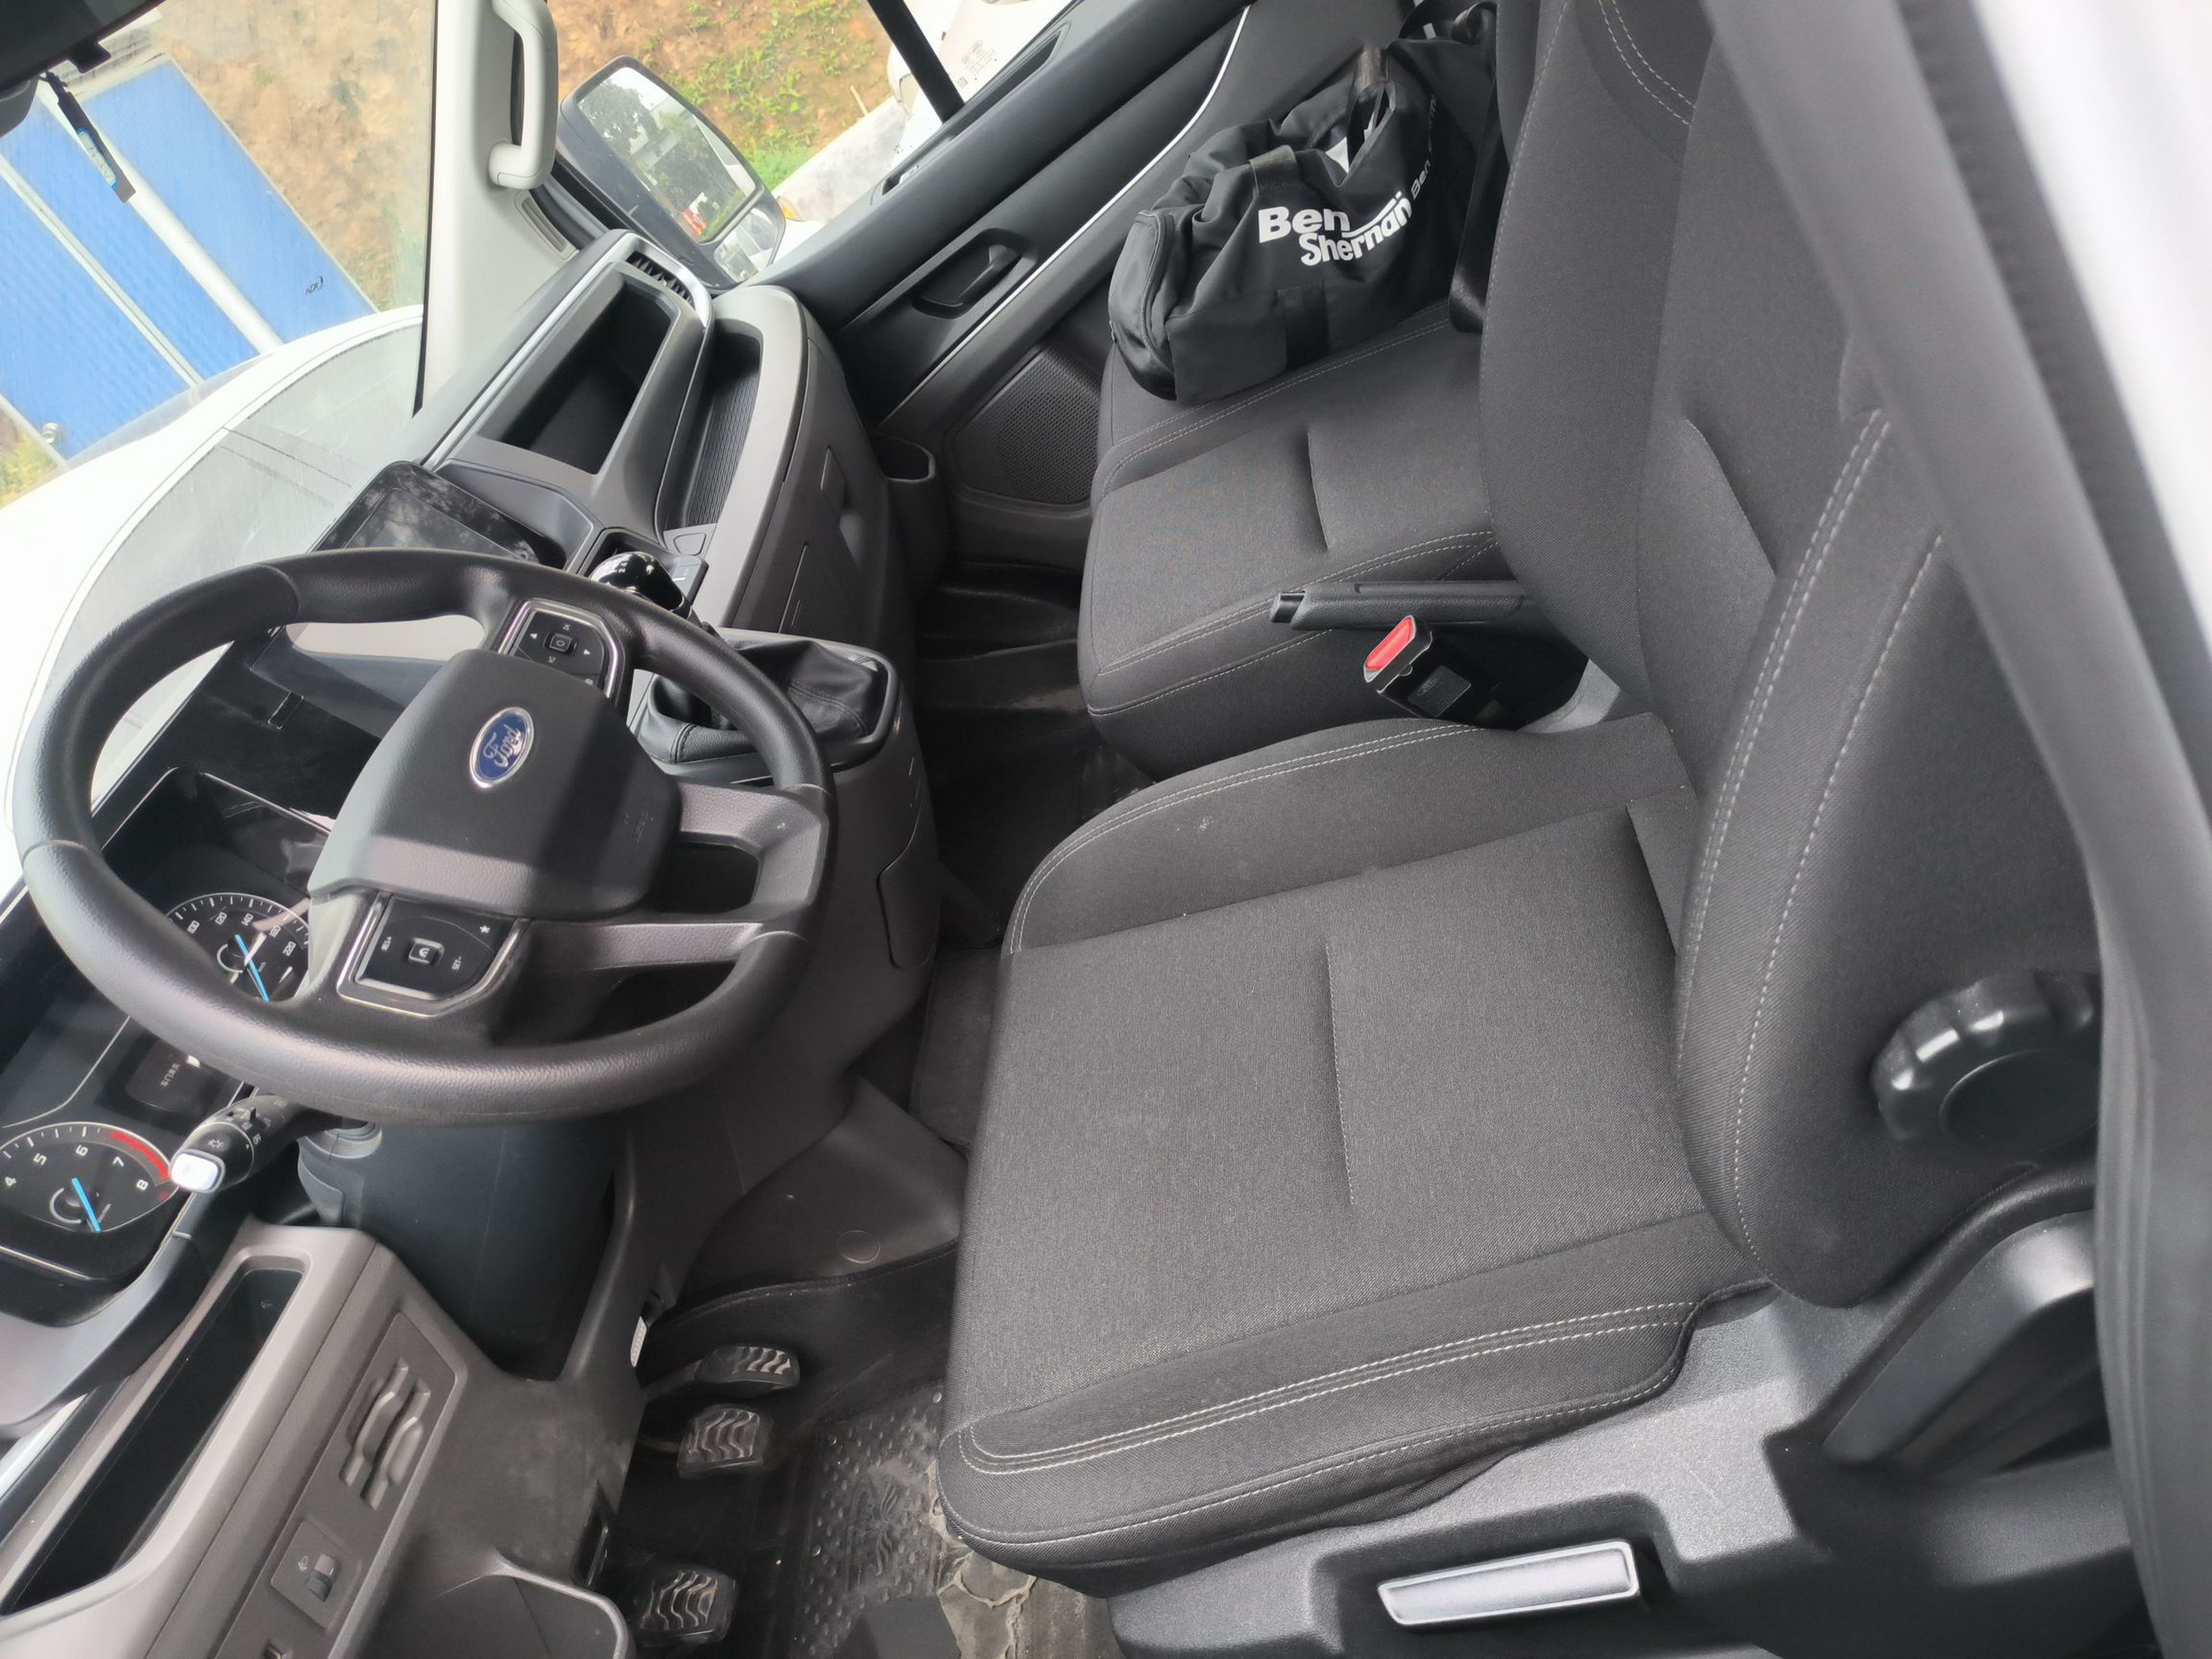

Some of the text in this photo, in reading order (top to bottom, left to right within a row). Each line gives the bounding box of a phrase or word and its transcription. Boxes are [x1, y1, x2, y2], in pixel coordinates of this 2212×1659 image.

[1411, 159, 1430, 199] Ben
[1259, 206, 1350, 243] Ben
[483, 723, 521, 767] Ford
[215, 912, 227, 925] 120
[241, 913, 253, 926] 140
[187, 920, 200, 934] 100
[282, 941, 296, 956] 220
[75, 1145, 88, 1156] 6
[33, 1153, 47, 1165] 5
[113, 1156, 124, 1167] 7
[5, 1176, 17, 1187] 4
[136, 1179, 149, 1190] 8
